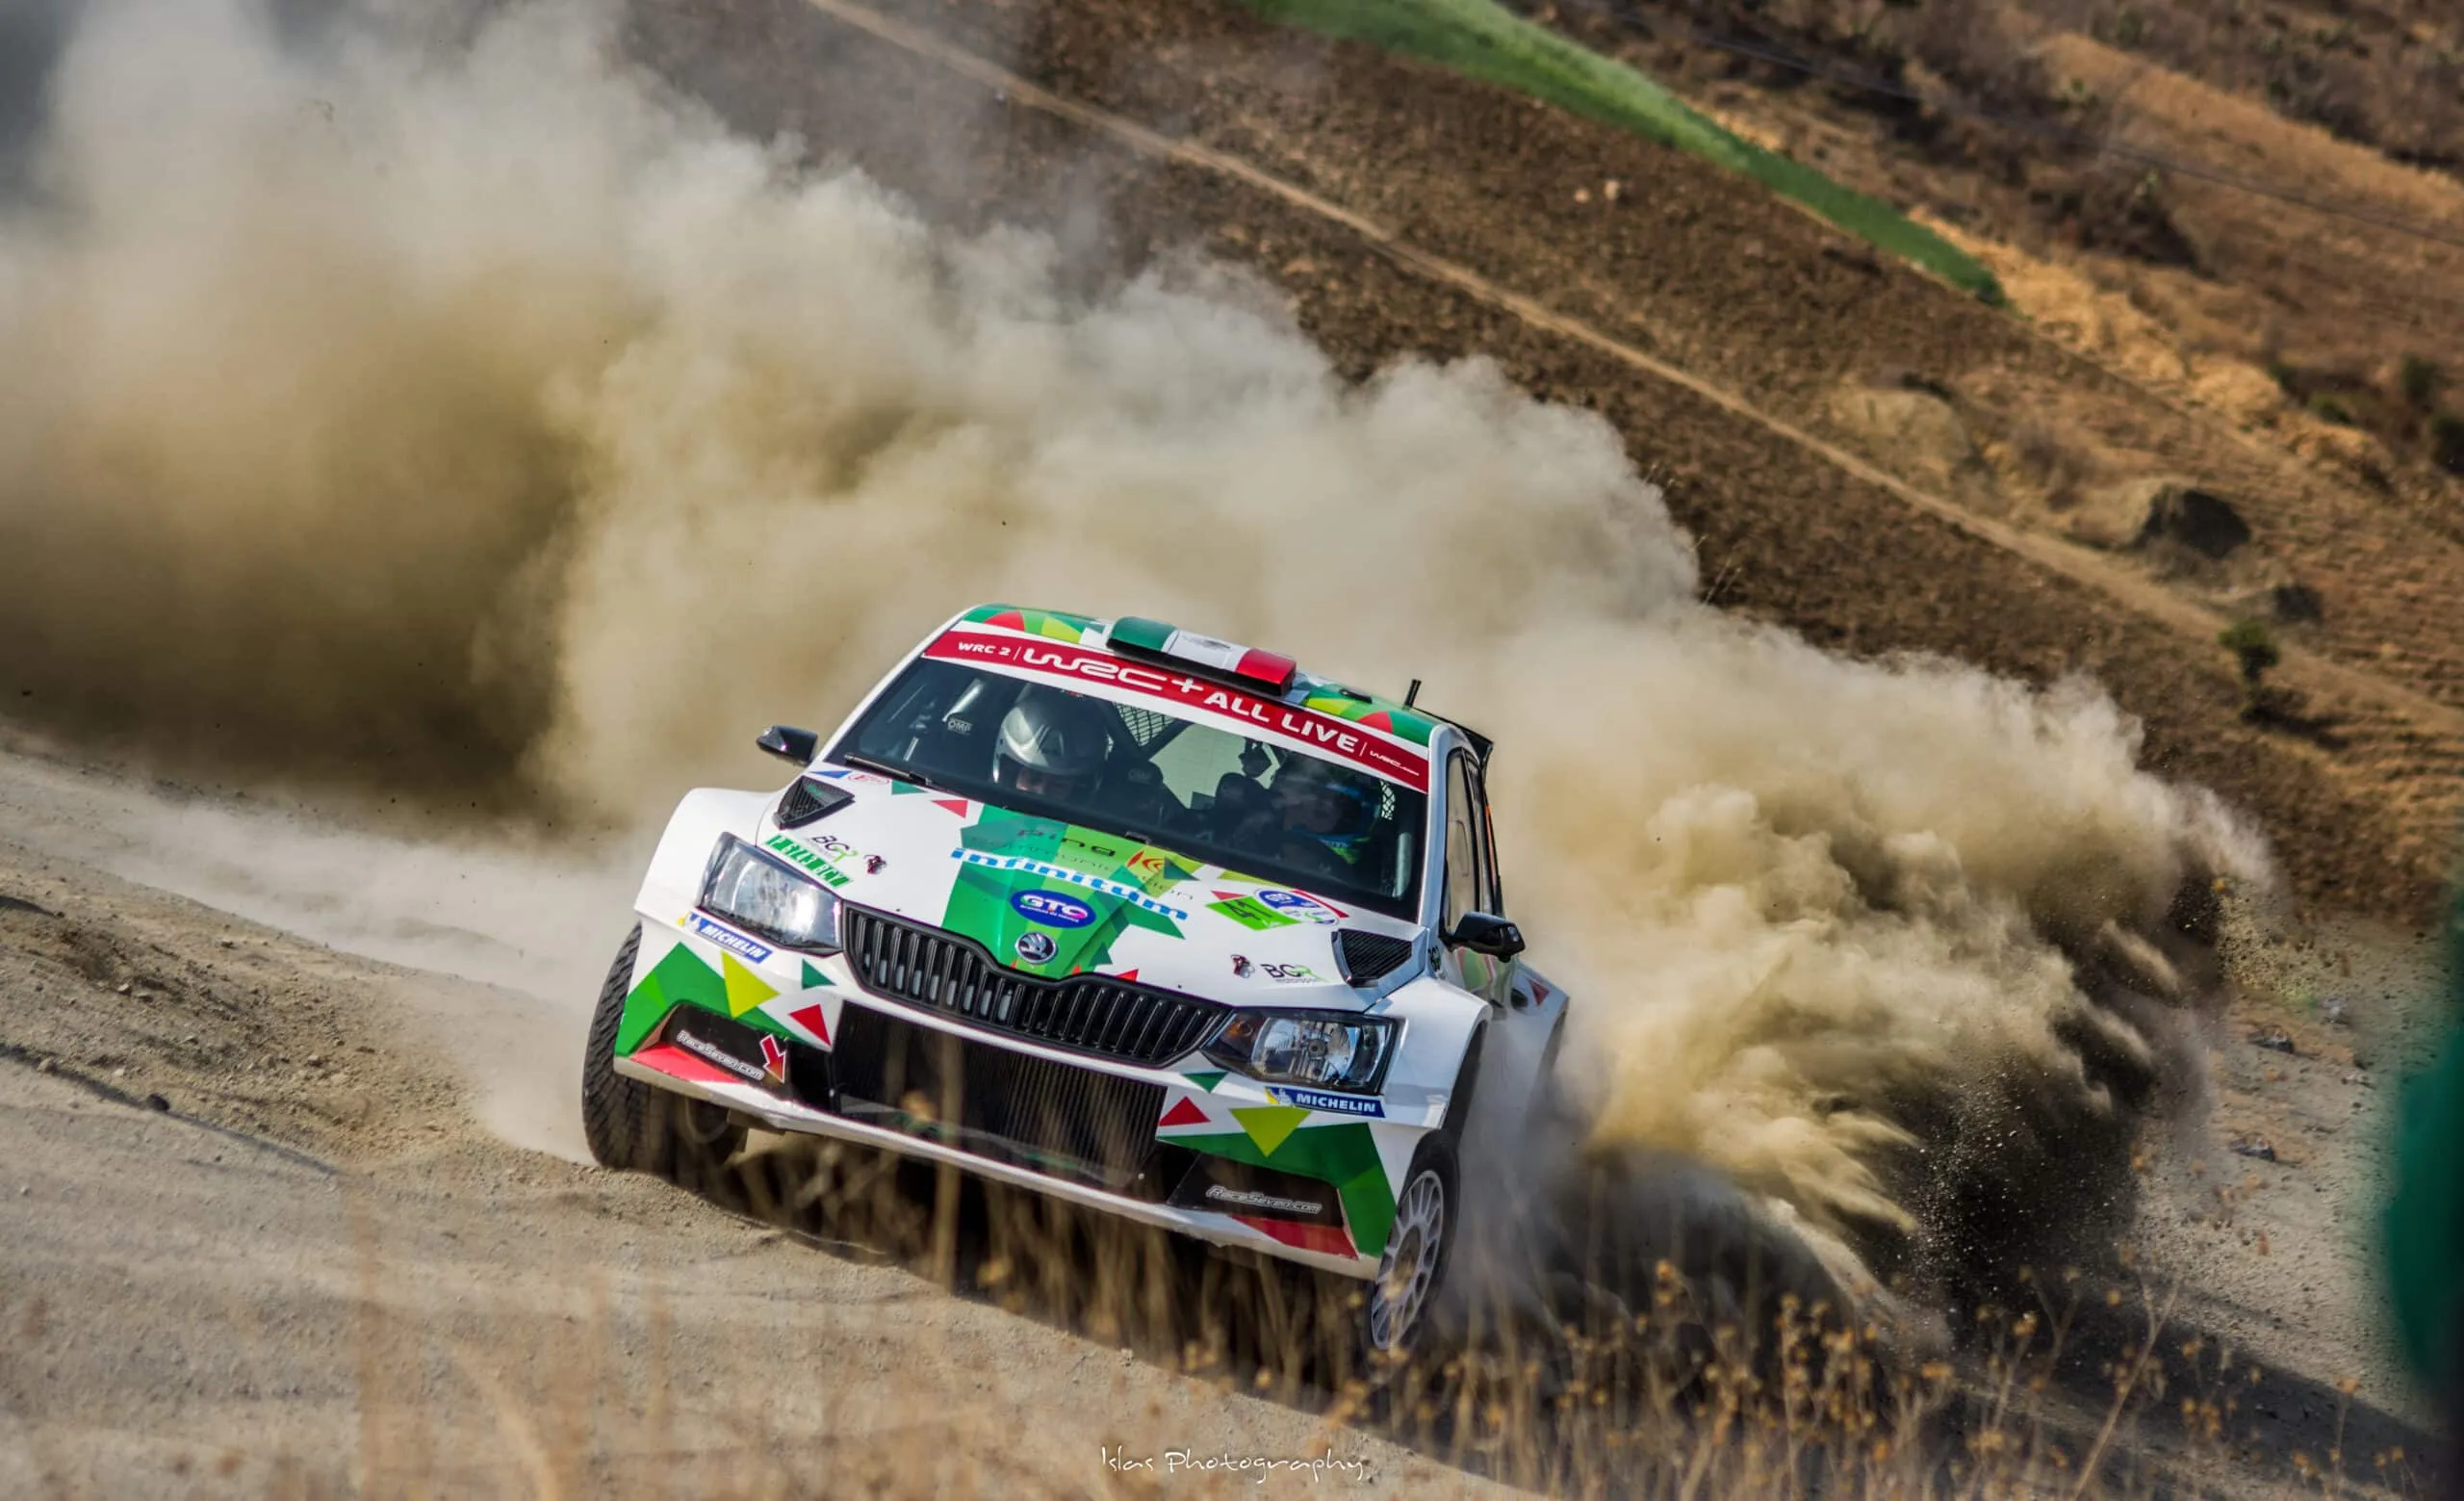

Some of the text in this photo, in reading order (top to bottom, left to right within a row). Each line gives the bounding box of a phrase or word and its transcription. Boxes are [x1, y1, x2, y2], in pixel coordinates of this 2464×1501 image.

[958, 641, 1011, 657] WRC 2
[1204, 691, 1270, 723] ALL
[1281, 712, 1359, 756] LIVE
[950, 847, 1190, 921] infinitum
[700, 924, 767, 959] MICHELIN
[1296, 1092, 1376, 1113] MICHELIN
